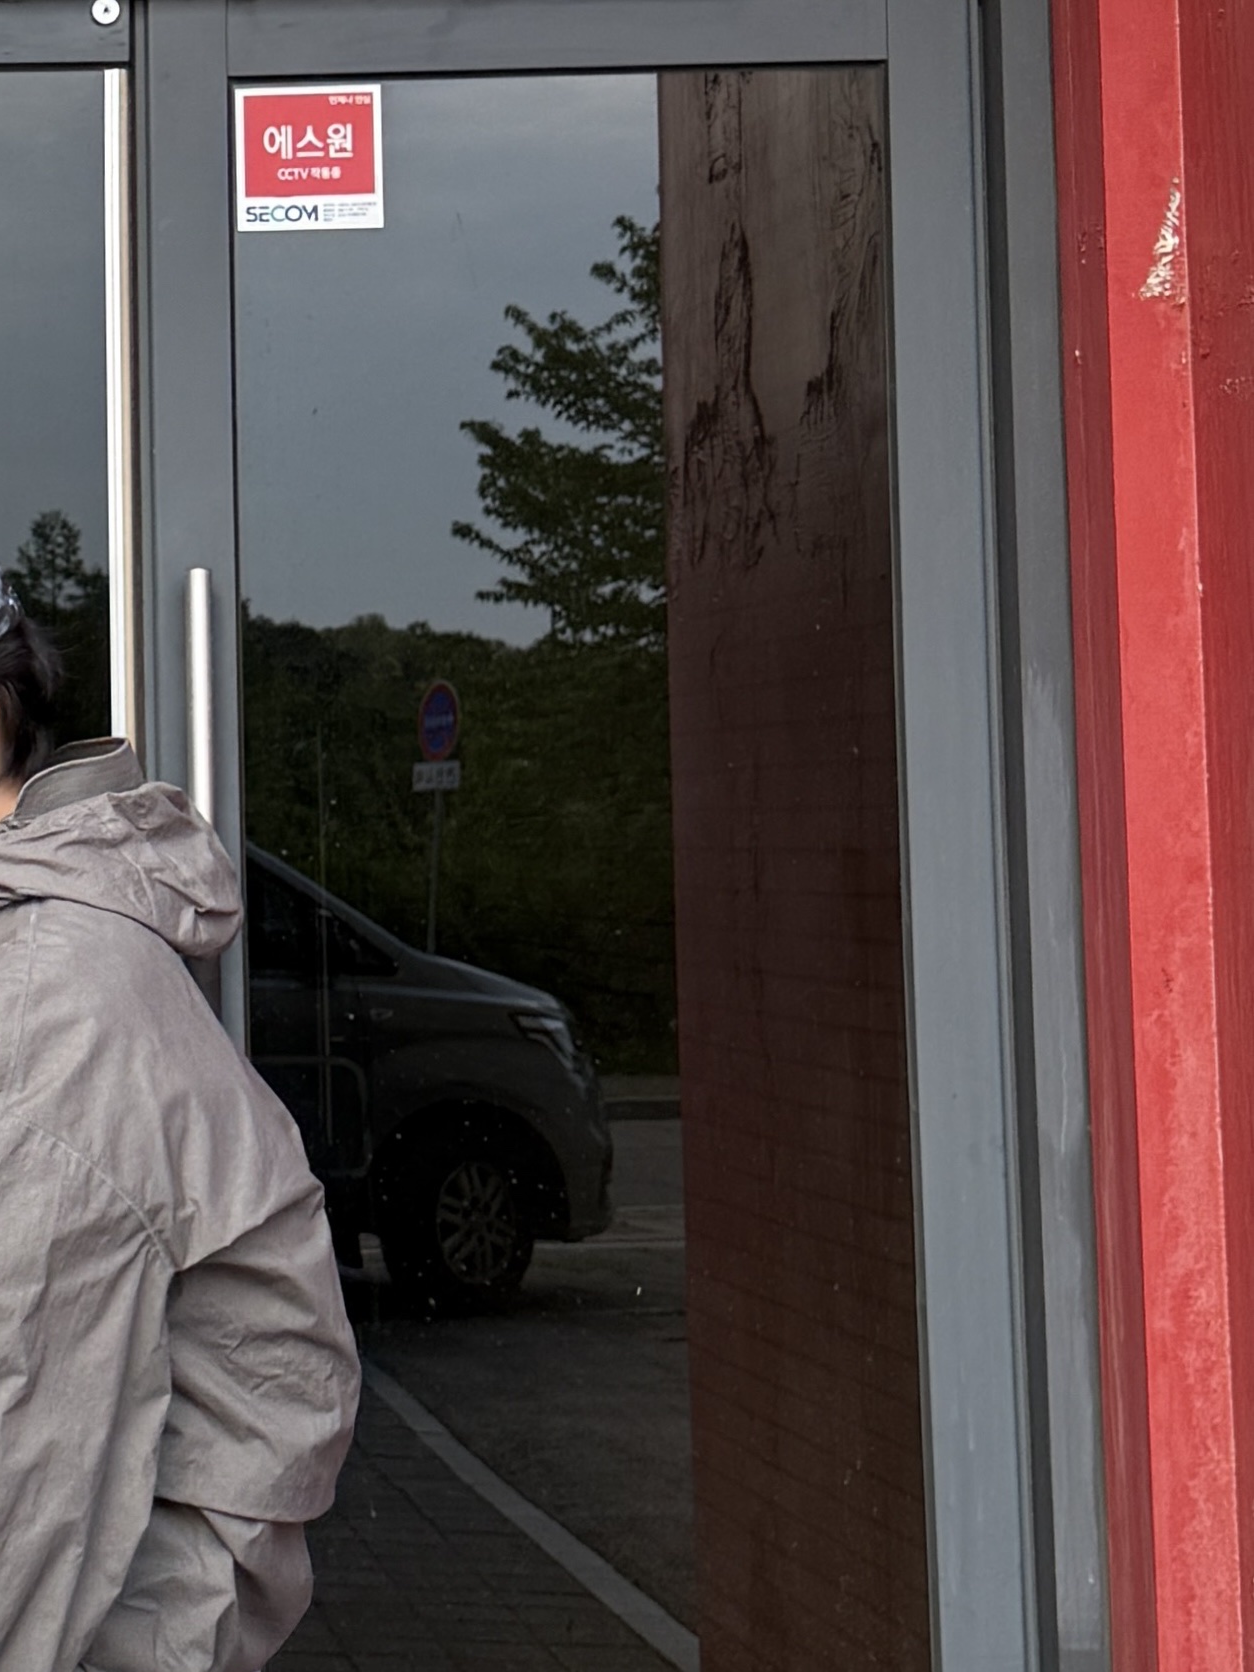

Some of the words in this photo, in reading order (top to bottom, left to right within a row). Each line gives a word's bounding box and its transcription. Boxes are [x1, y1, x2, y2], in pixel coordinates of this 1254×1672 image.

[263, 123, 354, 159] 에스원
[277, 168, 309, 180] CCTV
[246, 204, 319, 222] SECOM
